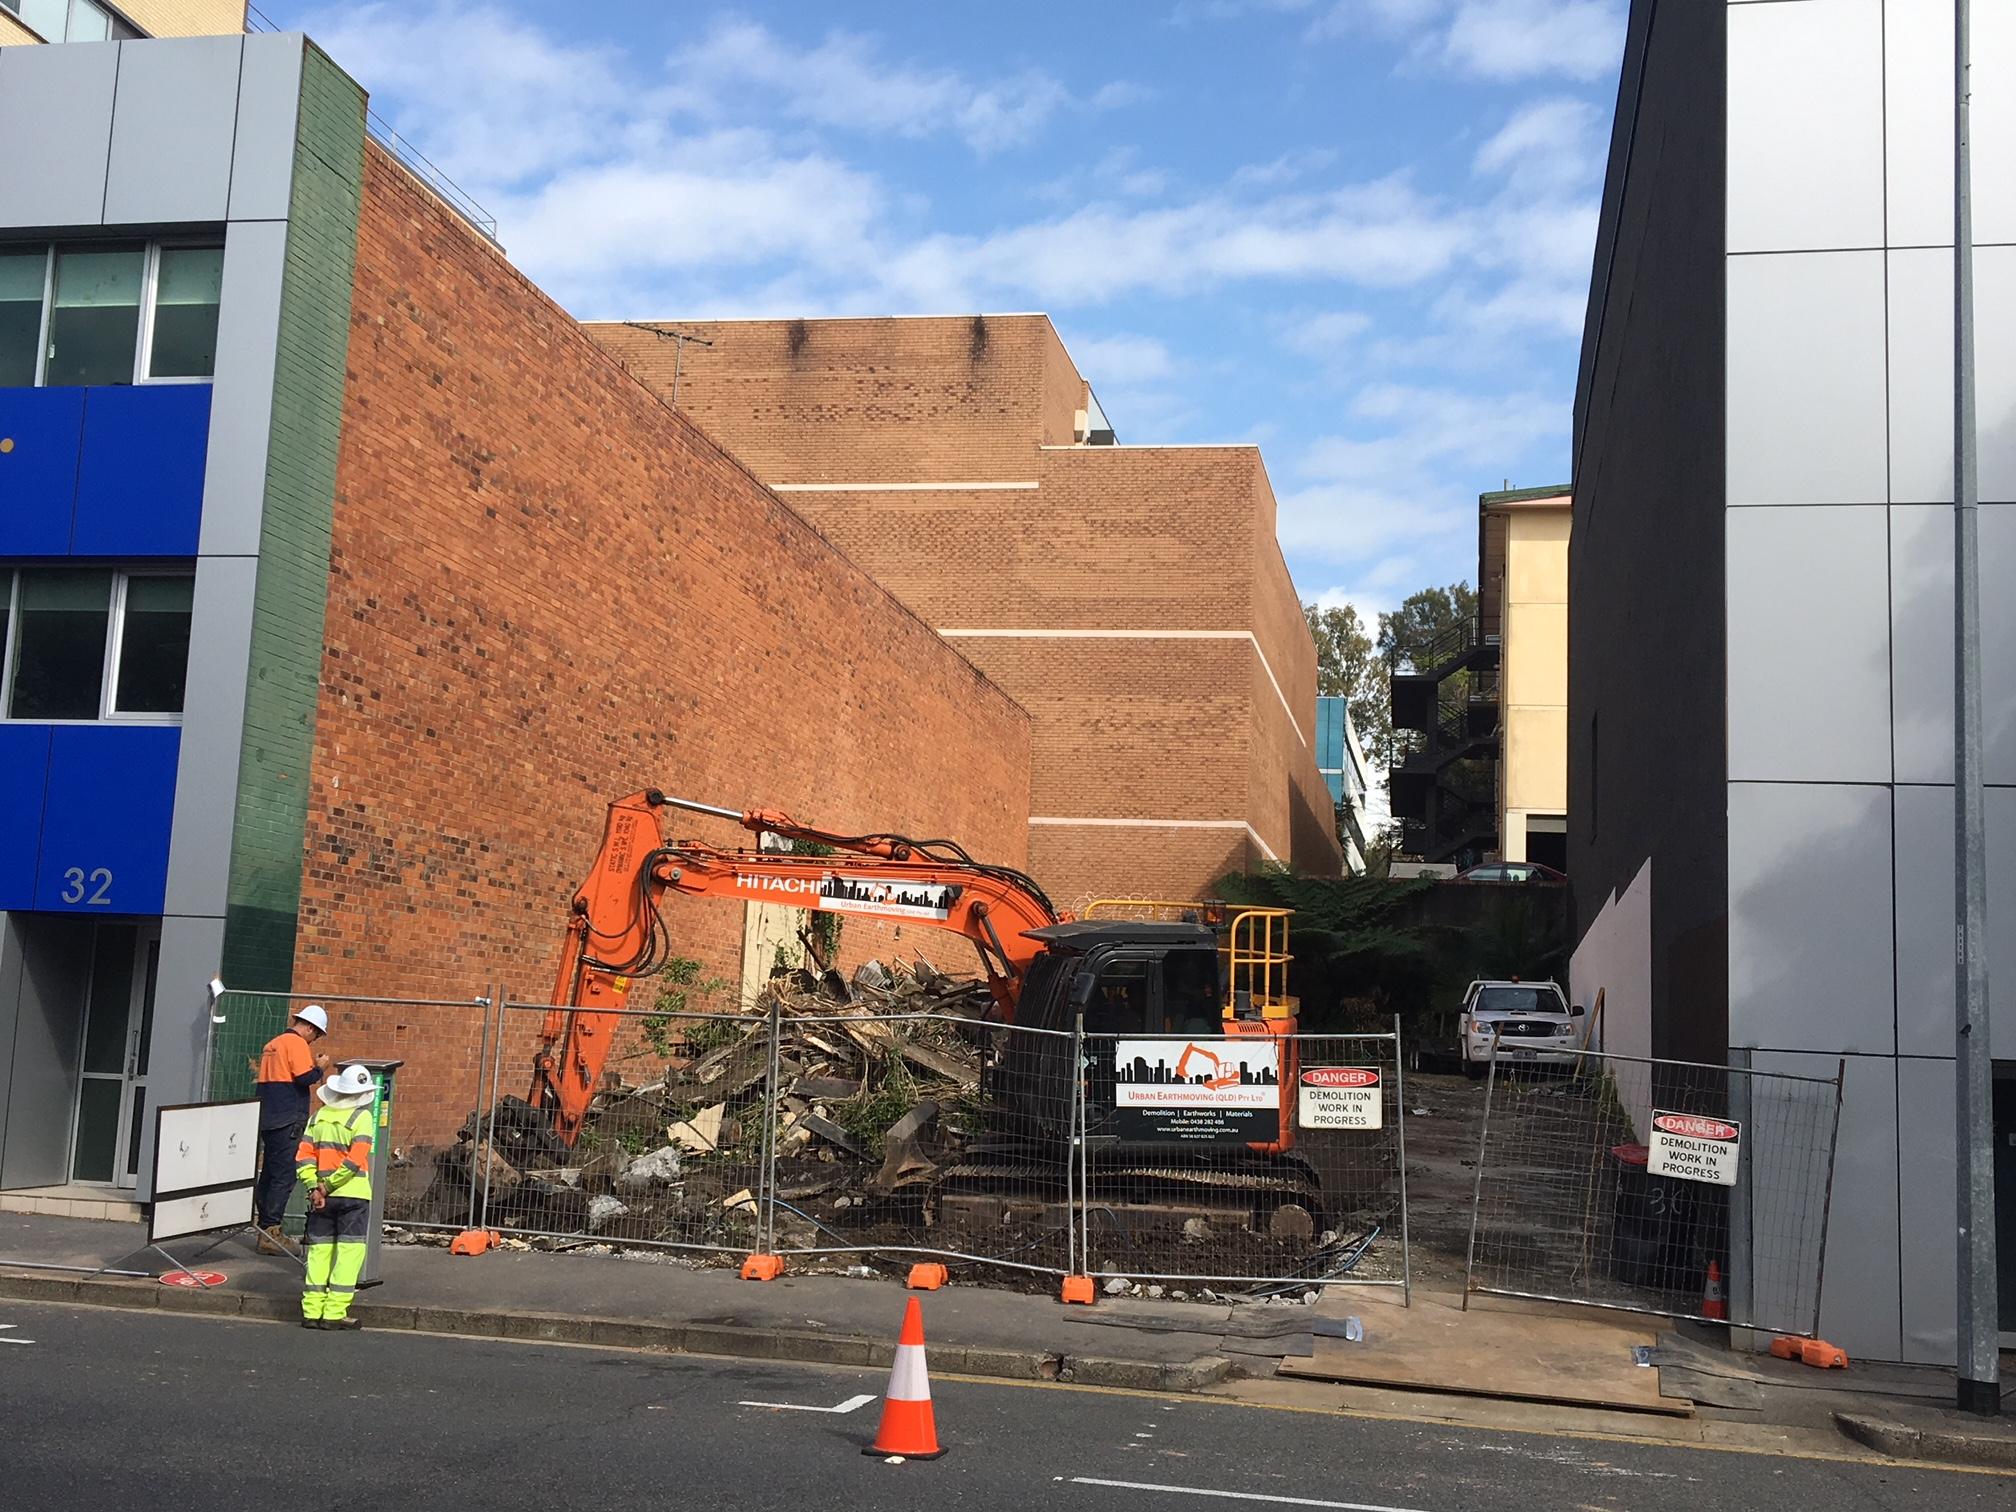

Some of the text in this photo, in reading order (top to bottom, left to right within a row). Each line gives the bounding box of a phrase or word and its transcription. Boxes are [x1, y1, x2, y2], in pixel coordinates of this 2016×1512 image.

[62, 867, 112, 904] 32
[736, 872, 821, 895] HITACHI
[840, 900, 862, 910] Urban
[863, 902, 906, 914] Earthmoving
[1312, 1072, 1367, 1083] DANGER
[1215, 1093, 1237, 1102] (QLD)
[1309, 1091, 1371, 1101] DEMOLITION
[1142, 1109, 1176, 1117] Demolition
[1225, 1110, 1254, 1118] Materials
[1318, 1104, 1363, 1113] WORK IN
[1313, 1115, 1367, 1125] PROGRESS
[1156, 1126, 1239, 1134] www.urbanearthmoving.com.au
[1666, 1118, 1725, 1136] DANGER
[1660, 1137, 1727, 1155] DEMOLITION
[1668, 1150, 1717, 1167] WORK IN
[1662, 1162, 1720, 1179] PROGRESS
